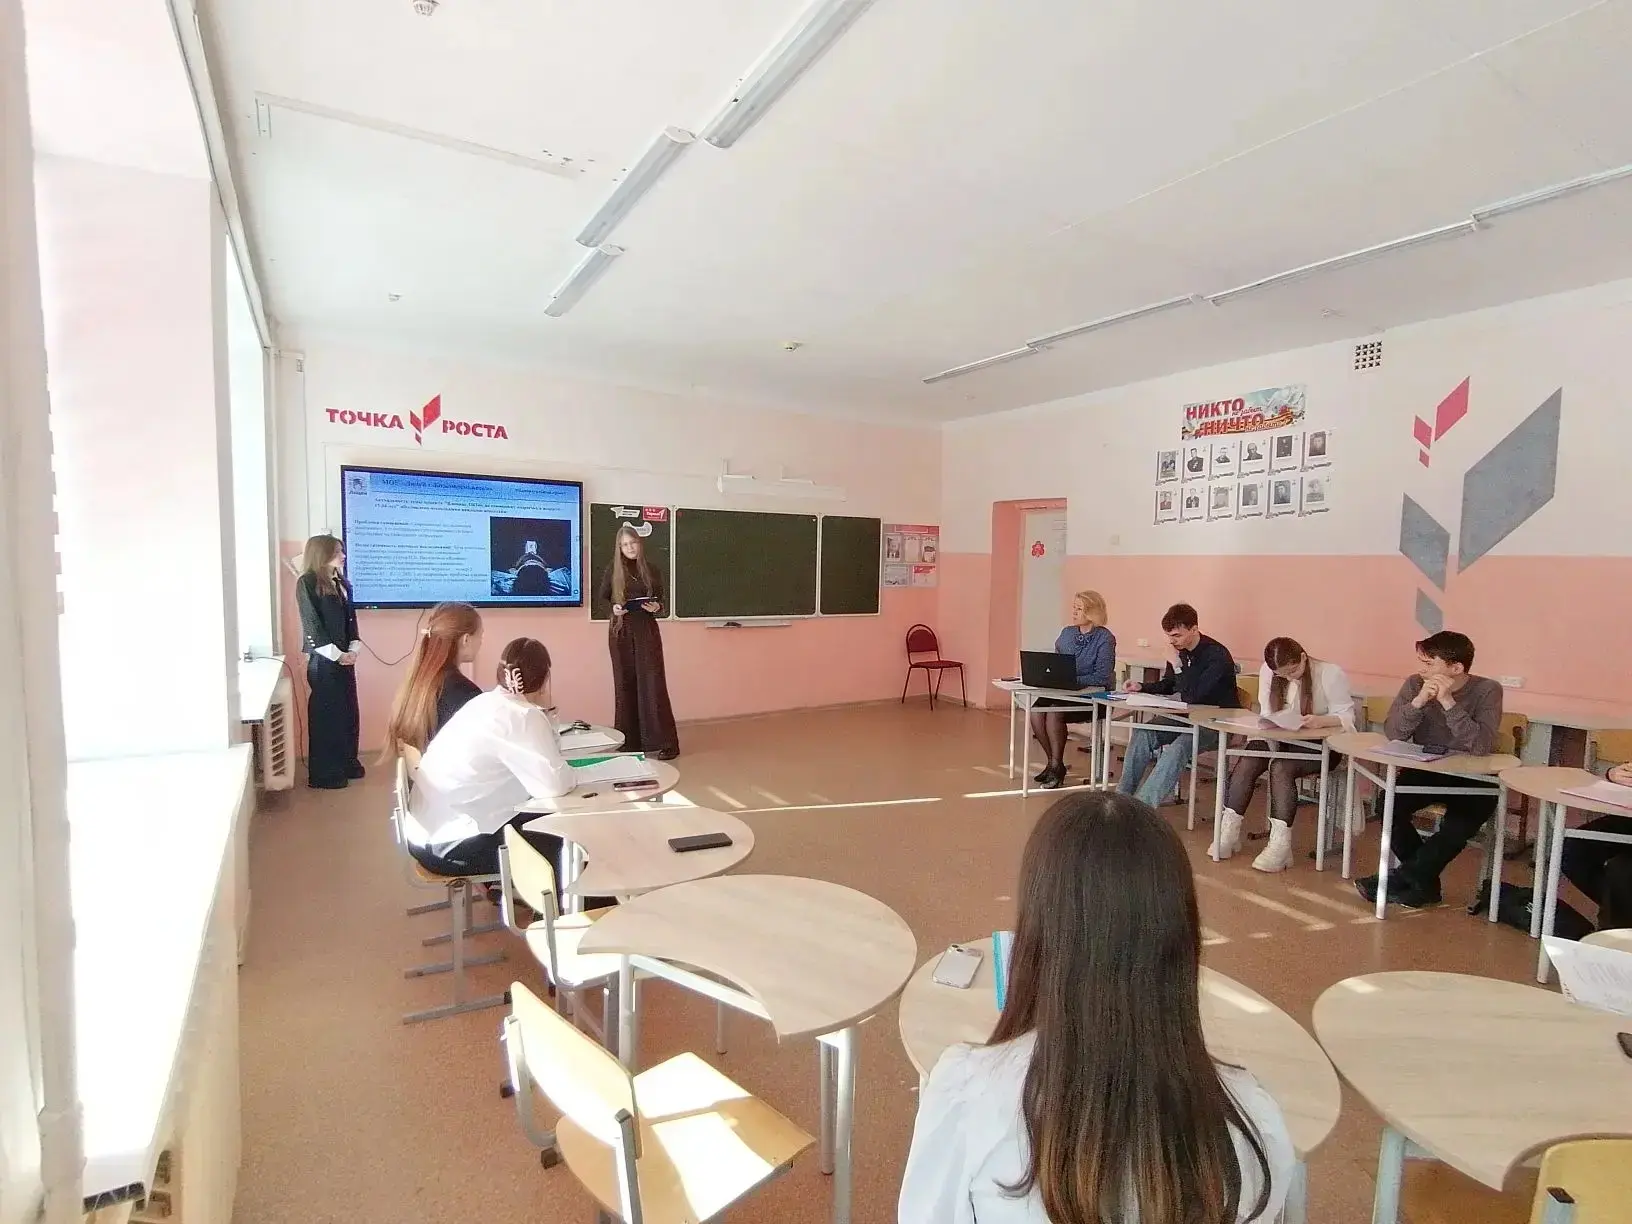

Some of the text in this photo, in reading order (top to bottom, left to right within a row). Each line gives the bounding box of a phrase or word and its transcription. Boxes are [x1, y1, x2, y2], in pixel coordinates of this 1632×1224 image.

[1186, 398, 1245, 420] НИКТО
[325, 408, 509, 440] ТОЧКА РОСТА
[1203, 414, 1264, 435] НИЧТО
